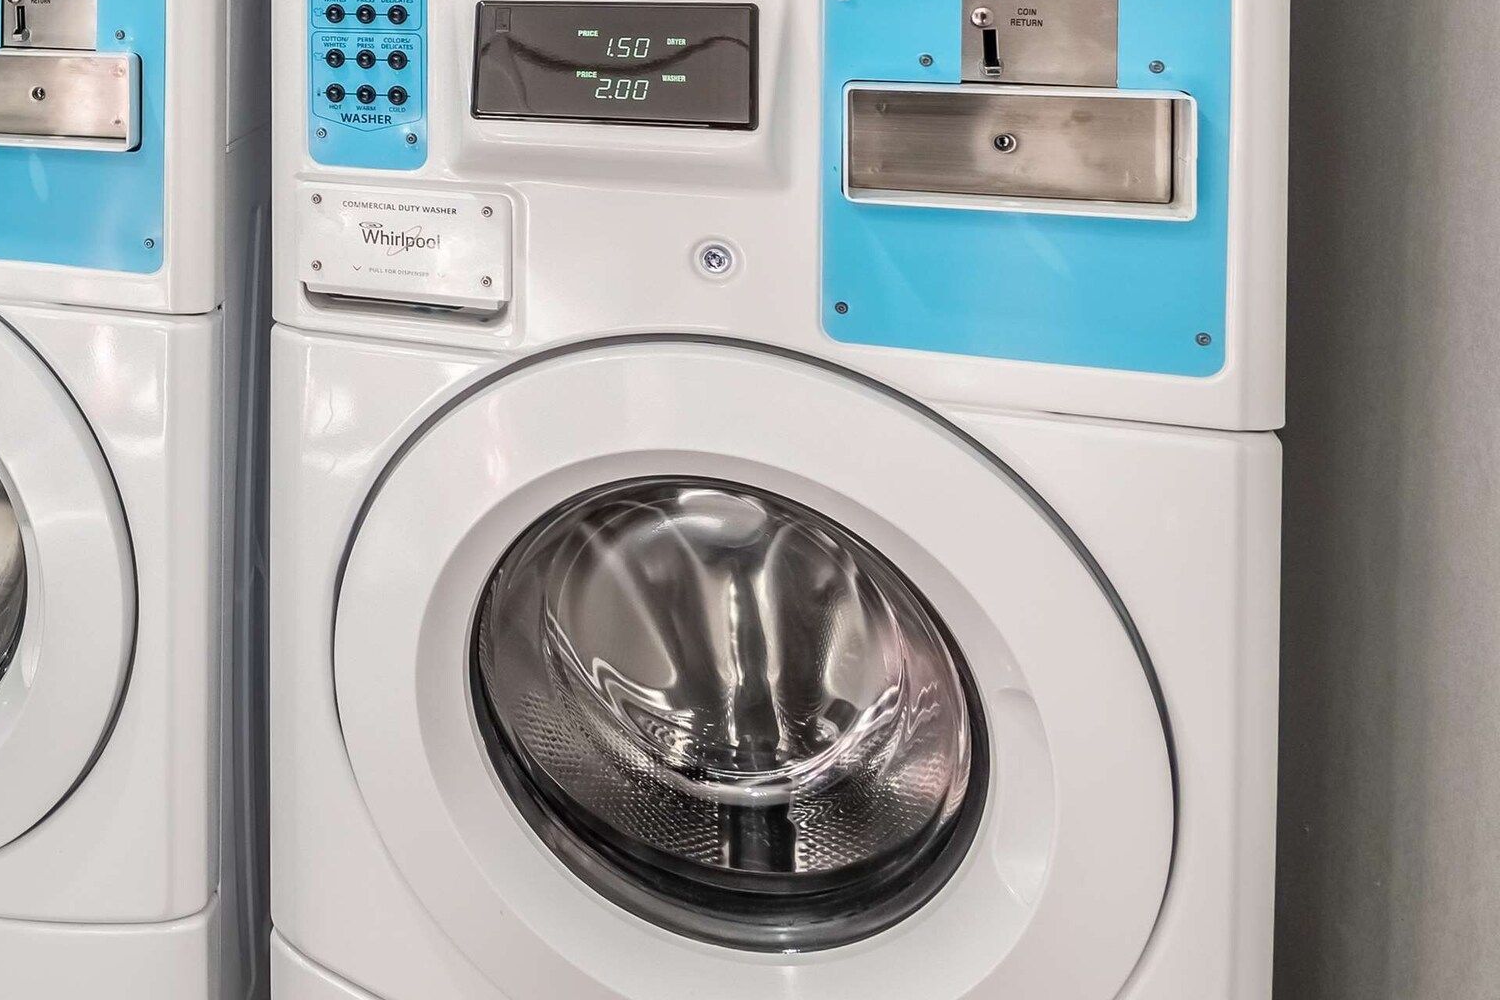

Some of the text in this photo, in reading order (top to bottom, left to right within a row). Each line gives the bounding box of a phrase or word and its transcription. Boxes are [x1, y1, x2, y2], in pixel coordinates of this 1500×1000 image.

[1017, 7, 1037, 16] COIN
[1010, 18, 1043, 27] RETURN
[577, 29, 687, 58] PRICE 1.50 DRYER
[576, 70, 686, 100] PRICE 2.00 WASHER
[340, 112, 392, 125] WASHER
[342, 200, 457, 215] COMMERCIAL DUTY WASHER
[362, 228, 440, 251] Whirlpool
